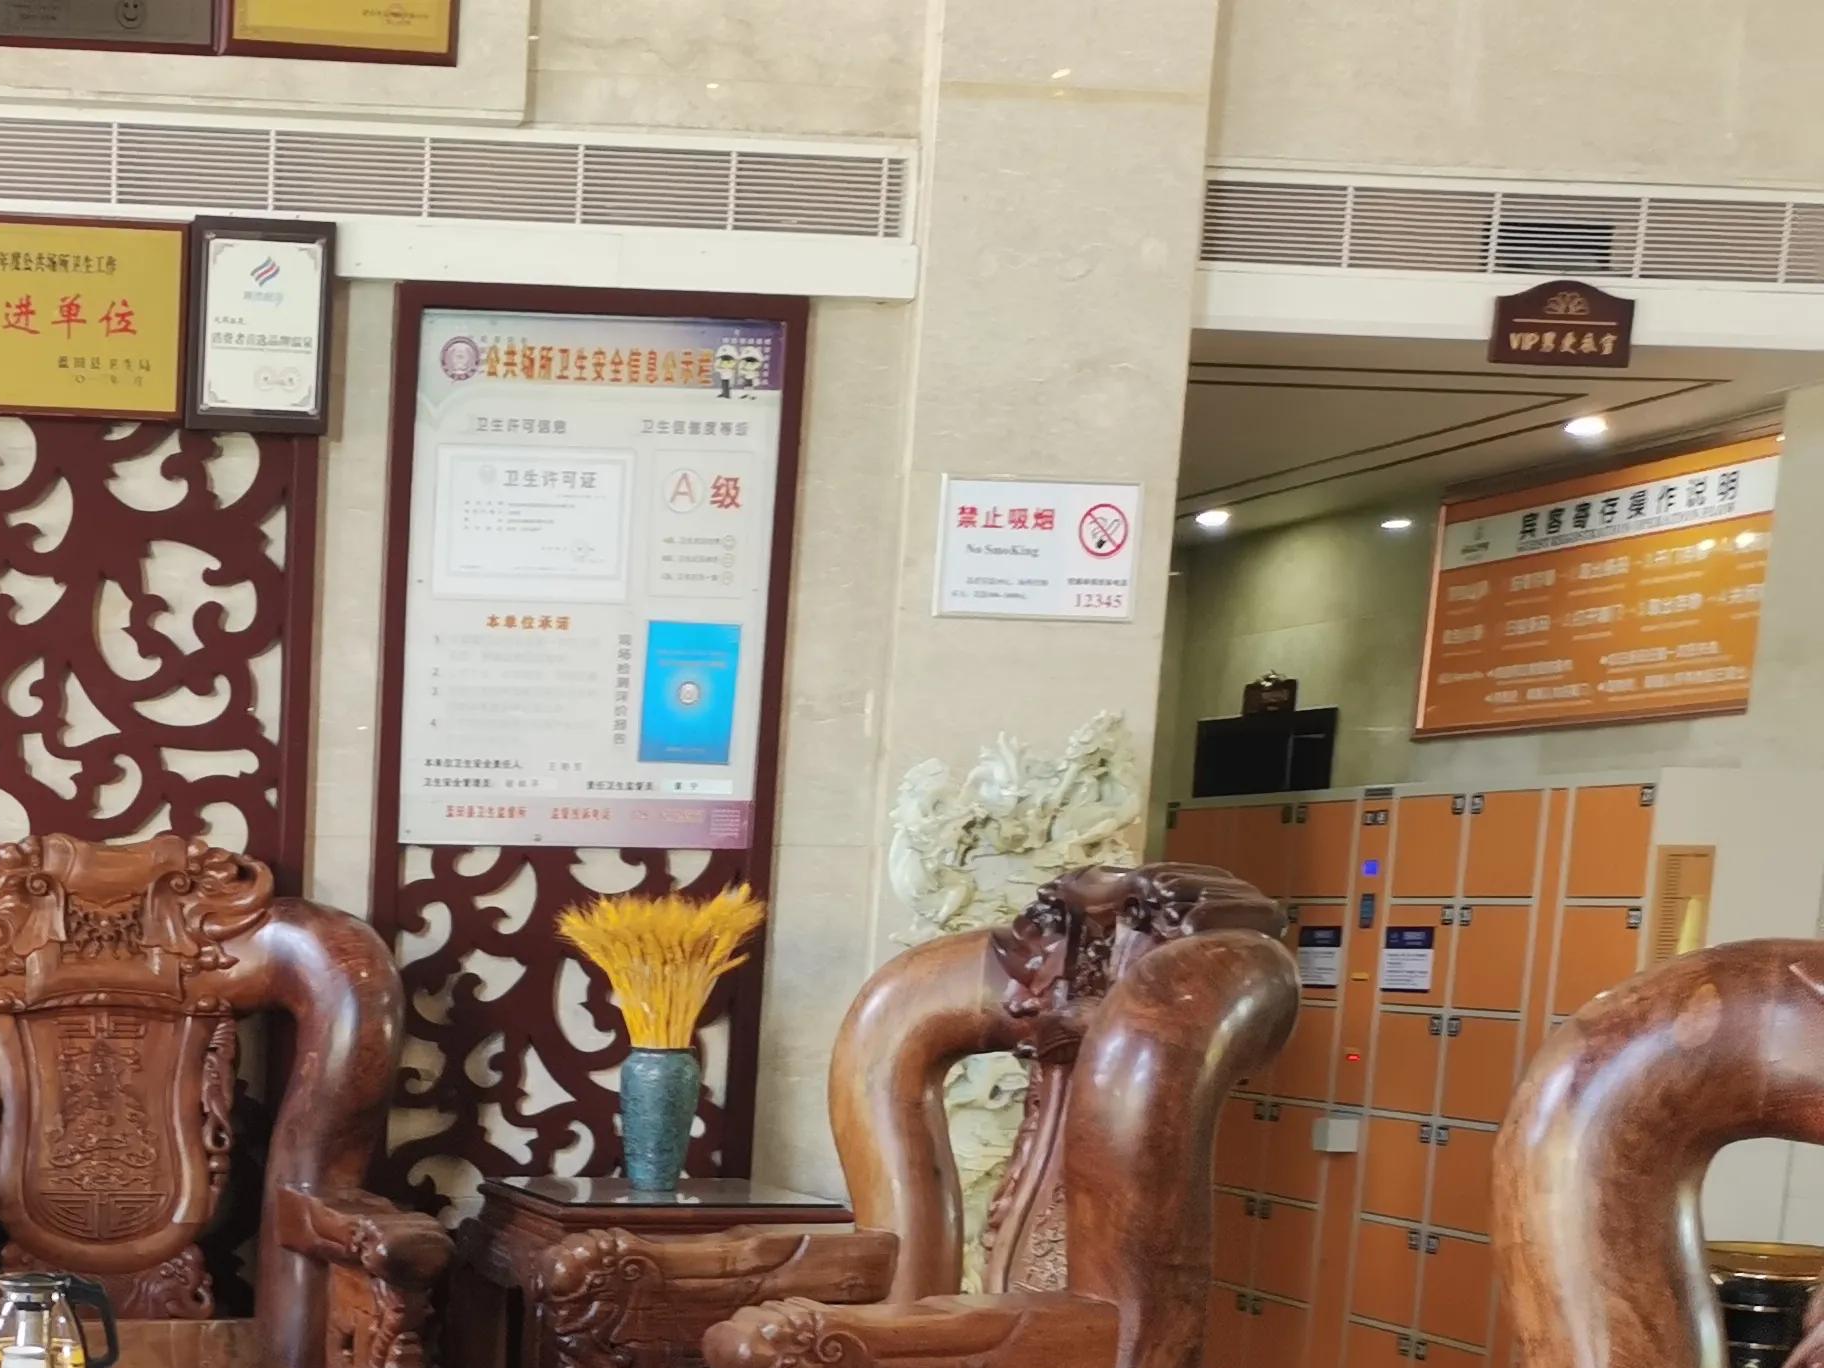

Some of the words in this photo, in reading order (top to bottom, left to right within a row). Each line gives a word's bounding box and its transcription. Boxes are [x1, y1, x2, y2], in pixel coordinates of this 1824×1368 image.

[486, 345, 714, 386] 公共场所卫生安全信息公示栏
[502, 469, 598, 489] 卫生许可证
[957, 505, 1056, 531] 禁止吸烟
[1075, 593, 1123, 608] 12345
